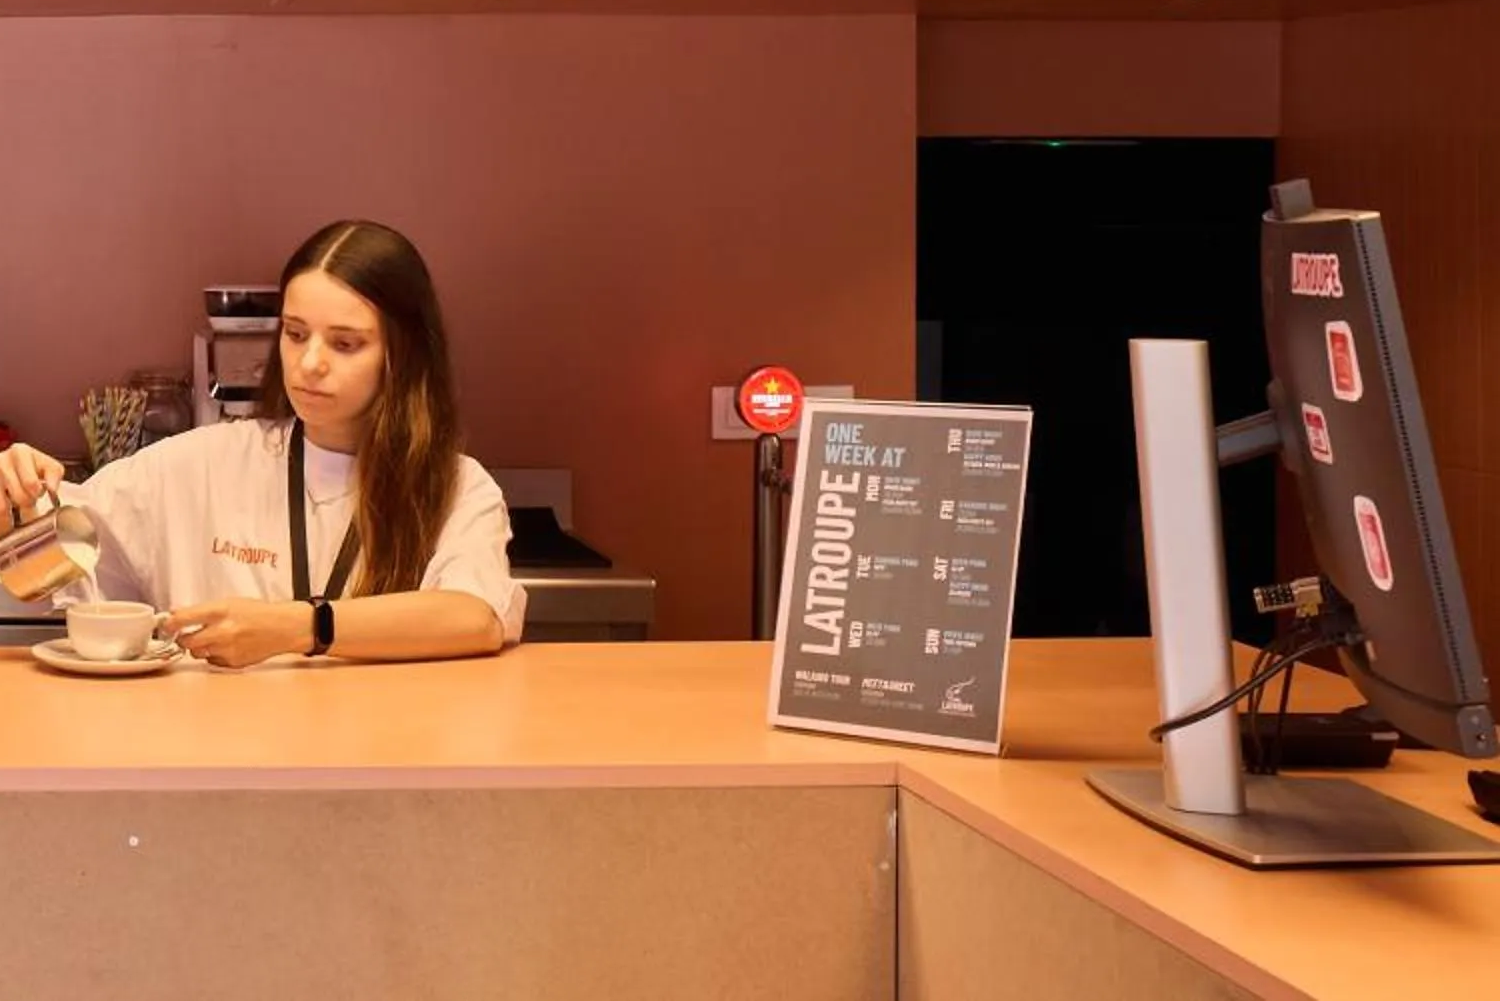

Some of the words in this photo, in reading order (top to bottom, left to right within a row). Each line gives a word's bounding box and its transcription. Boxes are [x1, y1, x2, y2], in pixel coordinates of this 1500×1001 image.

[827, 422, 864, 444] ONE
[825, 444, 877, 466] WEEK
[881, 447, 906, 468] AT
[865, 475, 880, 501] MON
[212, 537, 278, 568] LATROUPE
[800, 470, 861, 656] LATROUPE
[856, 555, 871, 578] TUE
[933, 556, 948, 581] SAT
[848, 621, 863, 647] WED
[925, 629, 940, 655] SUN
